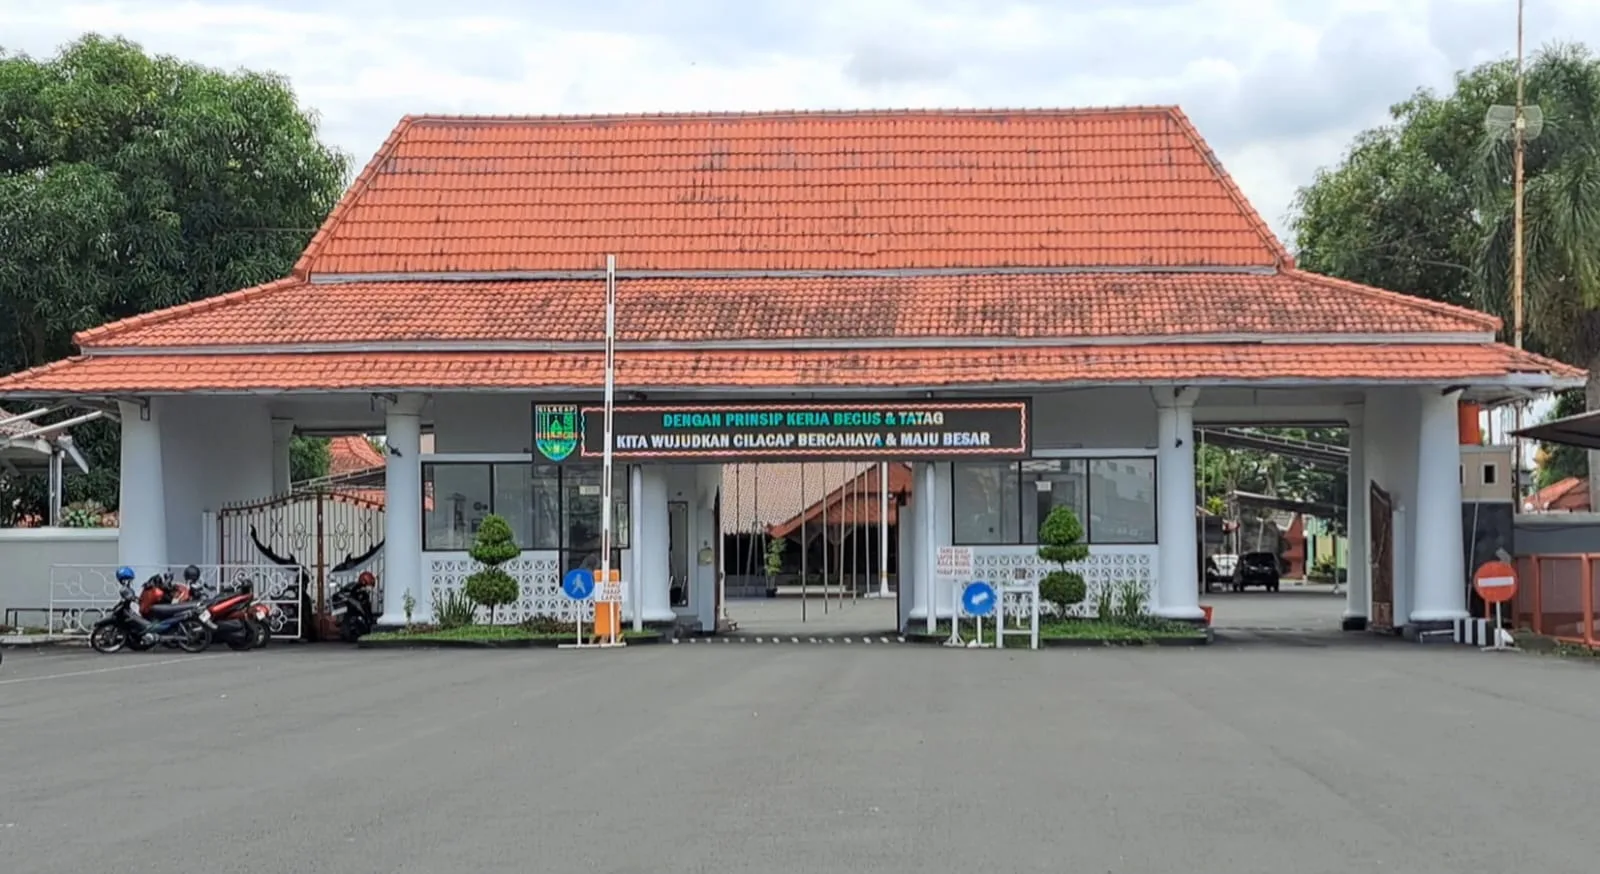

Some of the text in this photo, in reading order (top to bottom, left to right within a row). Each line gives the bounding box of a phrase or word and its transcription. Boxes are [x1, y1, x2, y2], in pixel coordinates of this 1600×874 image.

[663, 411, 944, 427] DENGAN PRINSIP KERJA BECUS & TATAG
[616, 431, 990, 449] KITA WUJUDKAN CILACAP BERCAHAYA & MAJU BESAR
